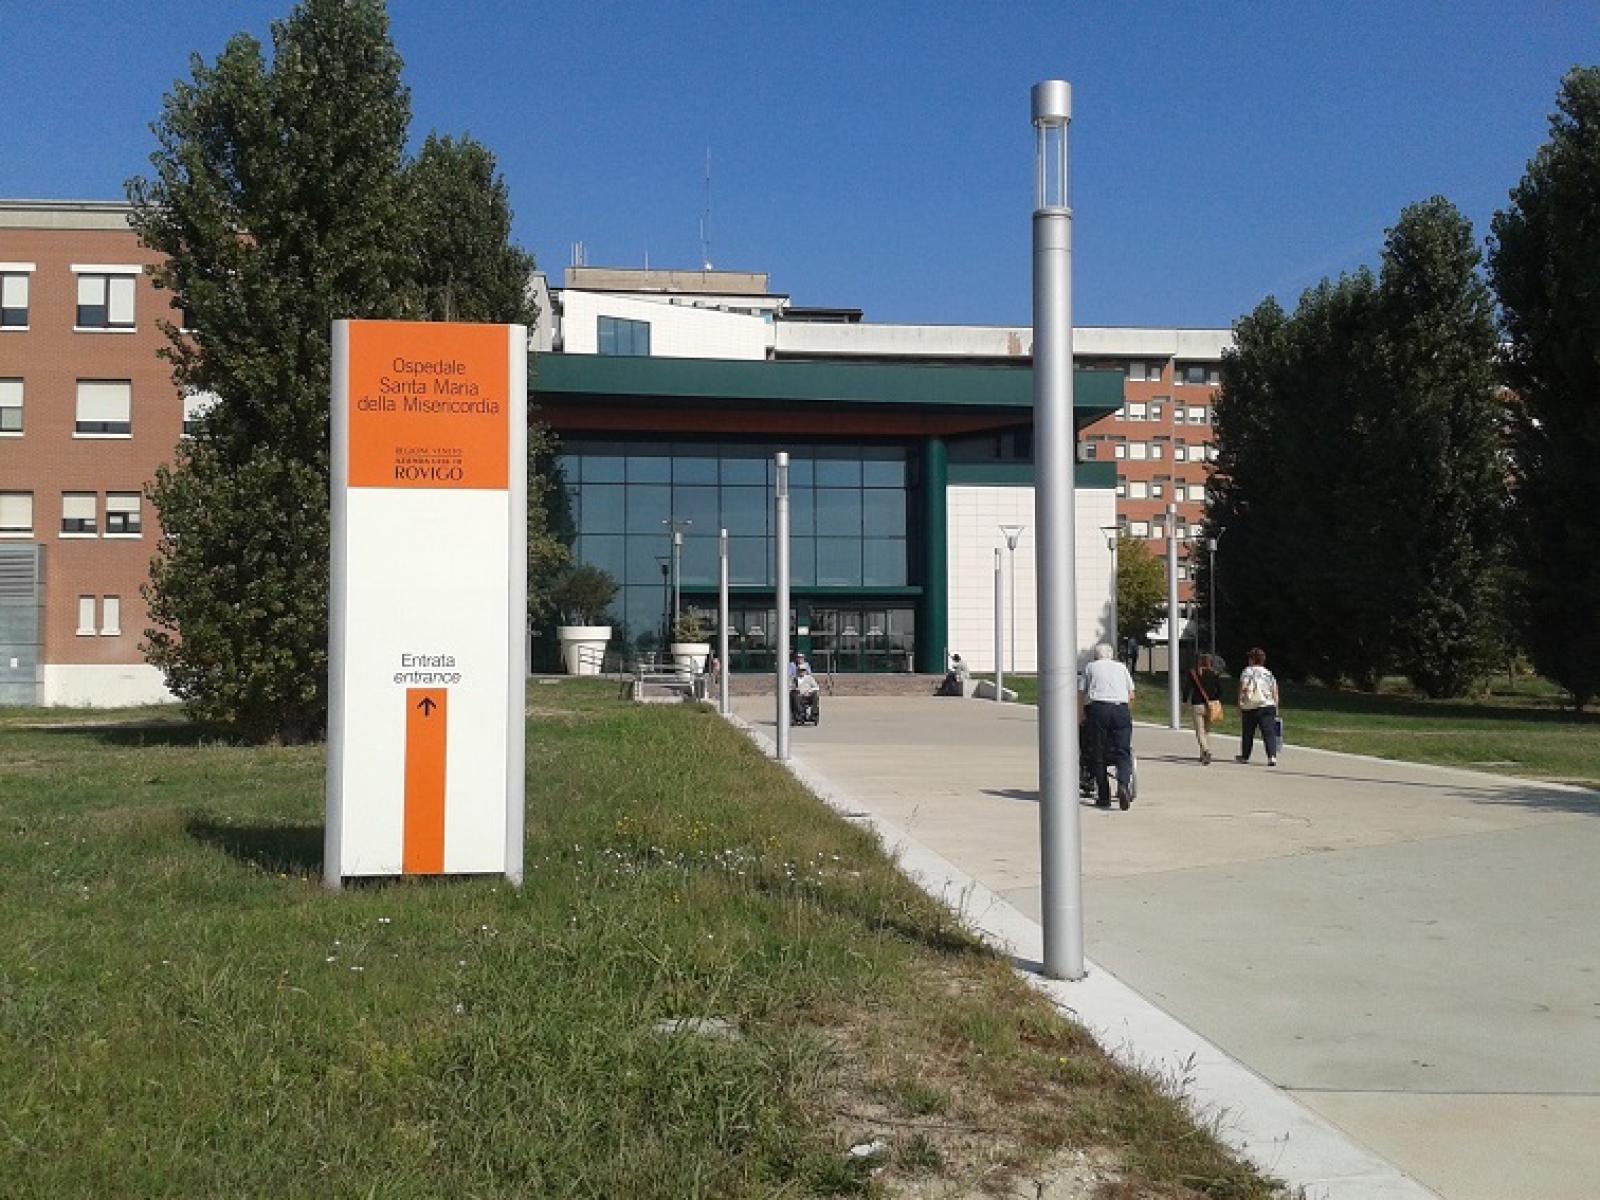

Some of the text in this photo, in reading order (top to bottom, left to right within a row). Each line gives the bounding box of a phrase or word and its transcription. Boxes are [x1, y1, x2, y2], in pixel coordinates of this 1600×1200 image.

[393, 357, 466, 377] Ospedale
[380, 376, 480, 396] Santa Maria
[357, 395, 500, 415] della Misericordia
[395, 465, 464, 481] ROVIGO
[401, 653, 456, 667] Entrata
[393, 671, 462, 684] entrance
